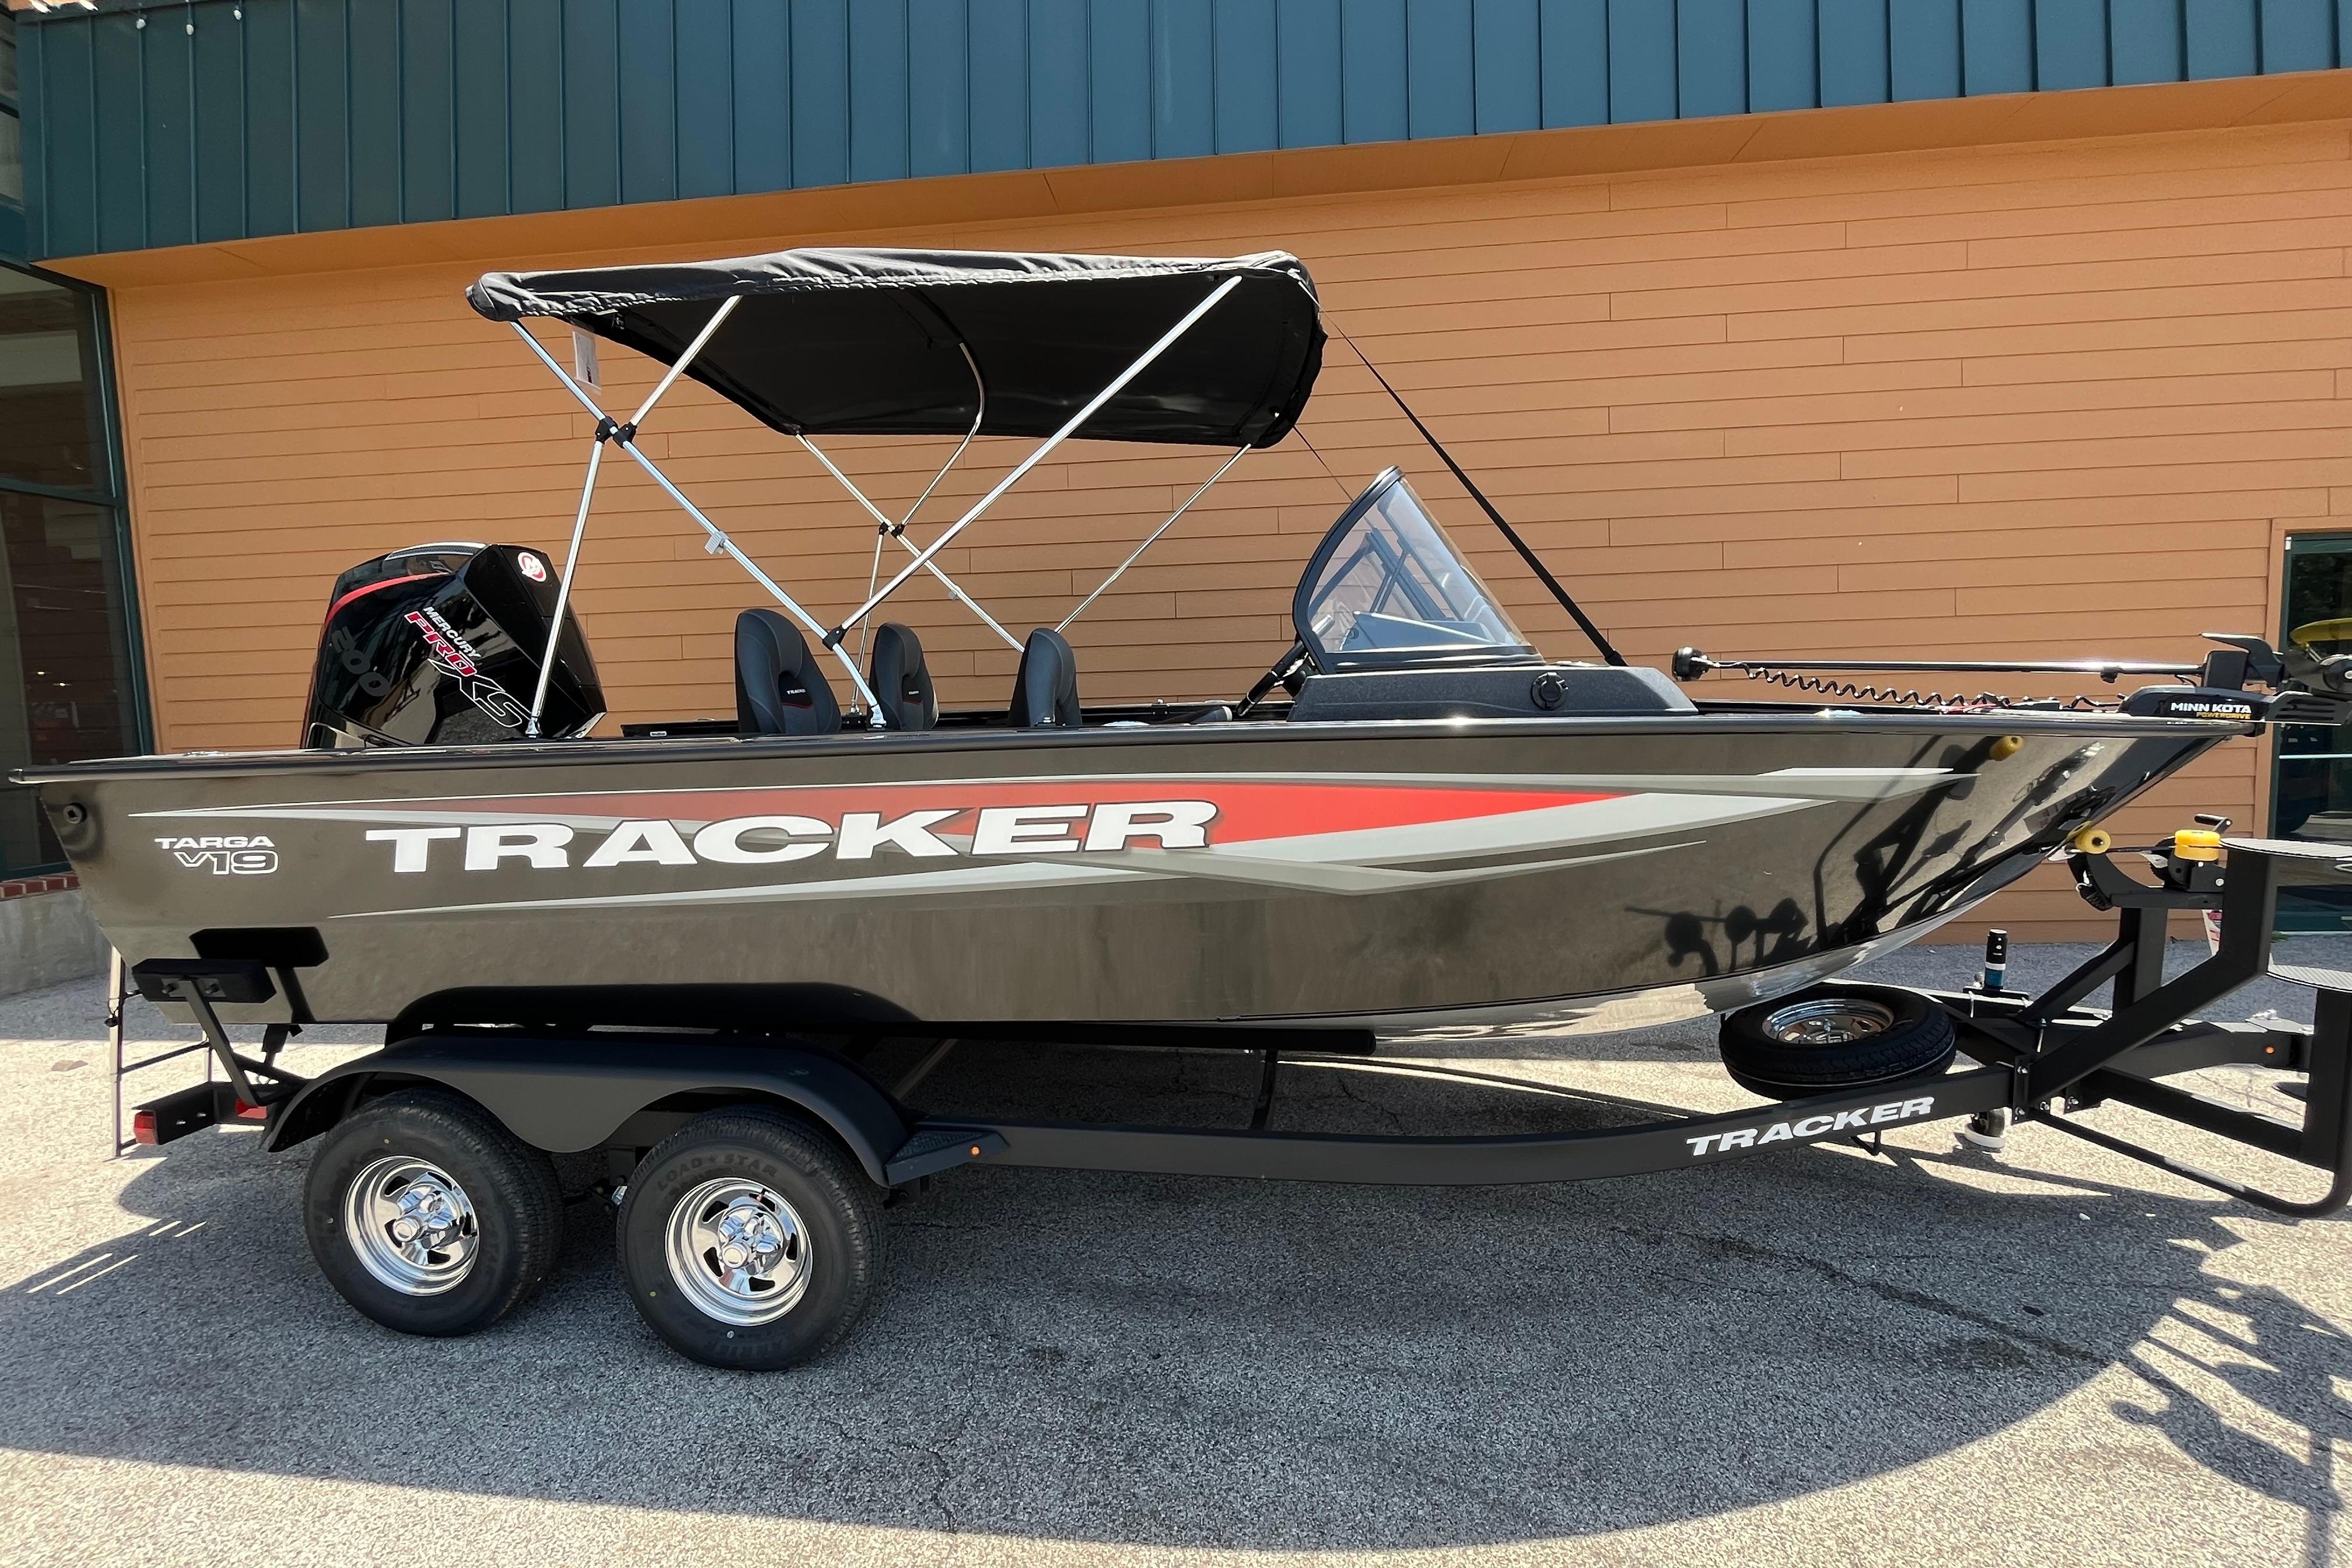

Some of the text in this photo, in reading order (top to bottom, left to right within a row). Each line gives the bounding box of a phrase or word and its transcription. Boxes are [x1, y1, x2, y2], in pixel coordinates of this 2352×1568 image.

[331, 626, 391, 697] 200
[404, 611, 477, 677] PRO
[424, 606, 481, 658] MERCURY
[428, 652, 532, 728] XS
[2171, 702, 2252, 713] MINN KOTA
[155, 835, 275, 849] TARGA
[173, 850, 279, 875] V19
[365, 800, 1217, 873] TRACKER
[1686, 1097, 1935, 1156] TRACKER
